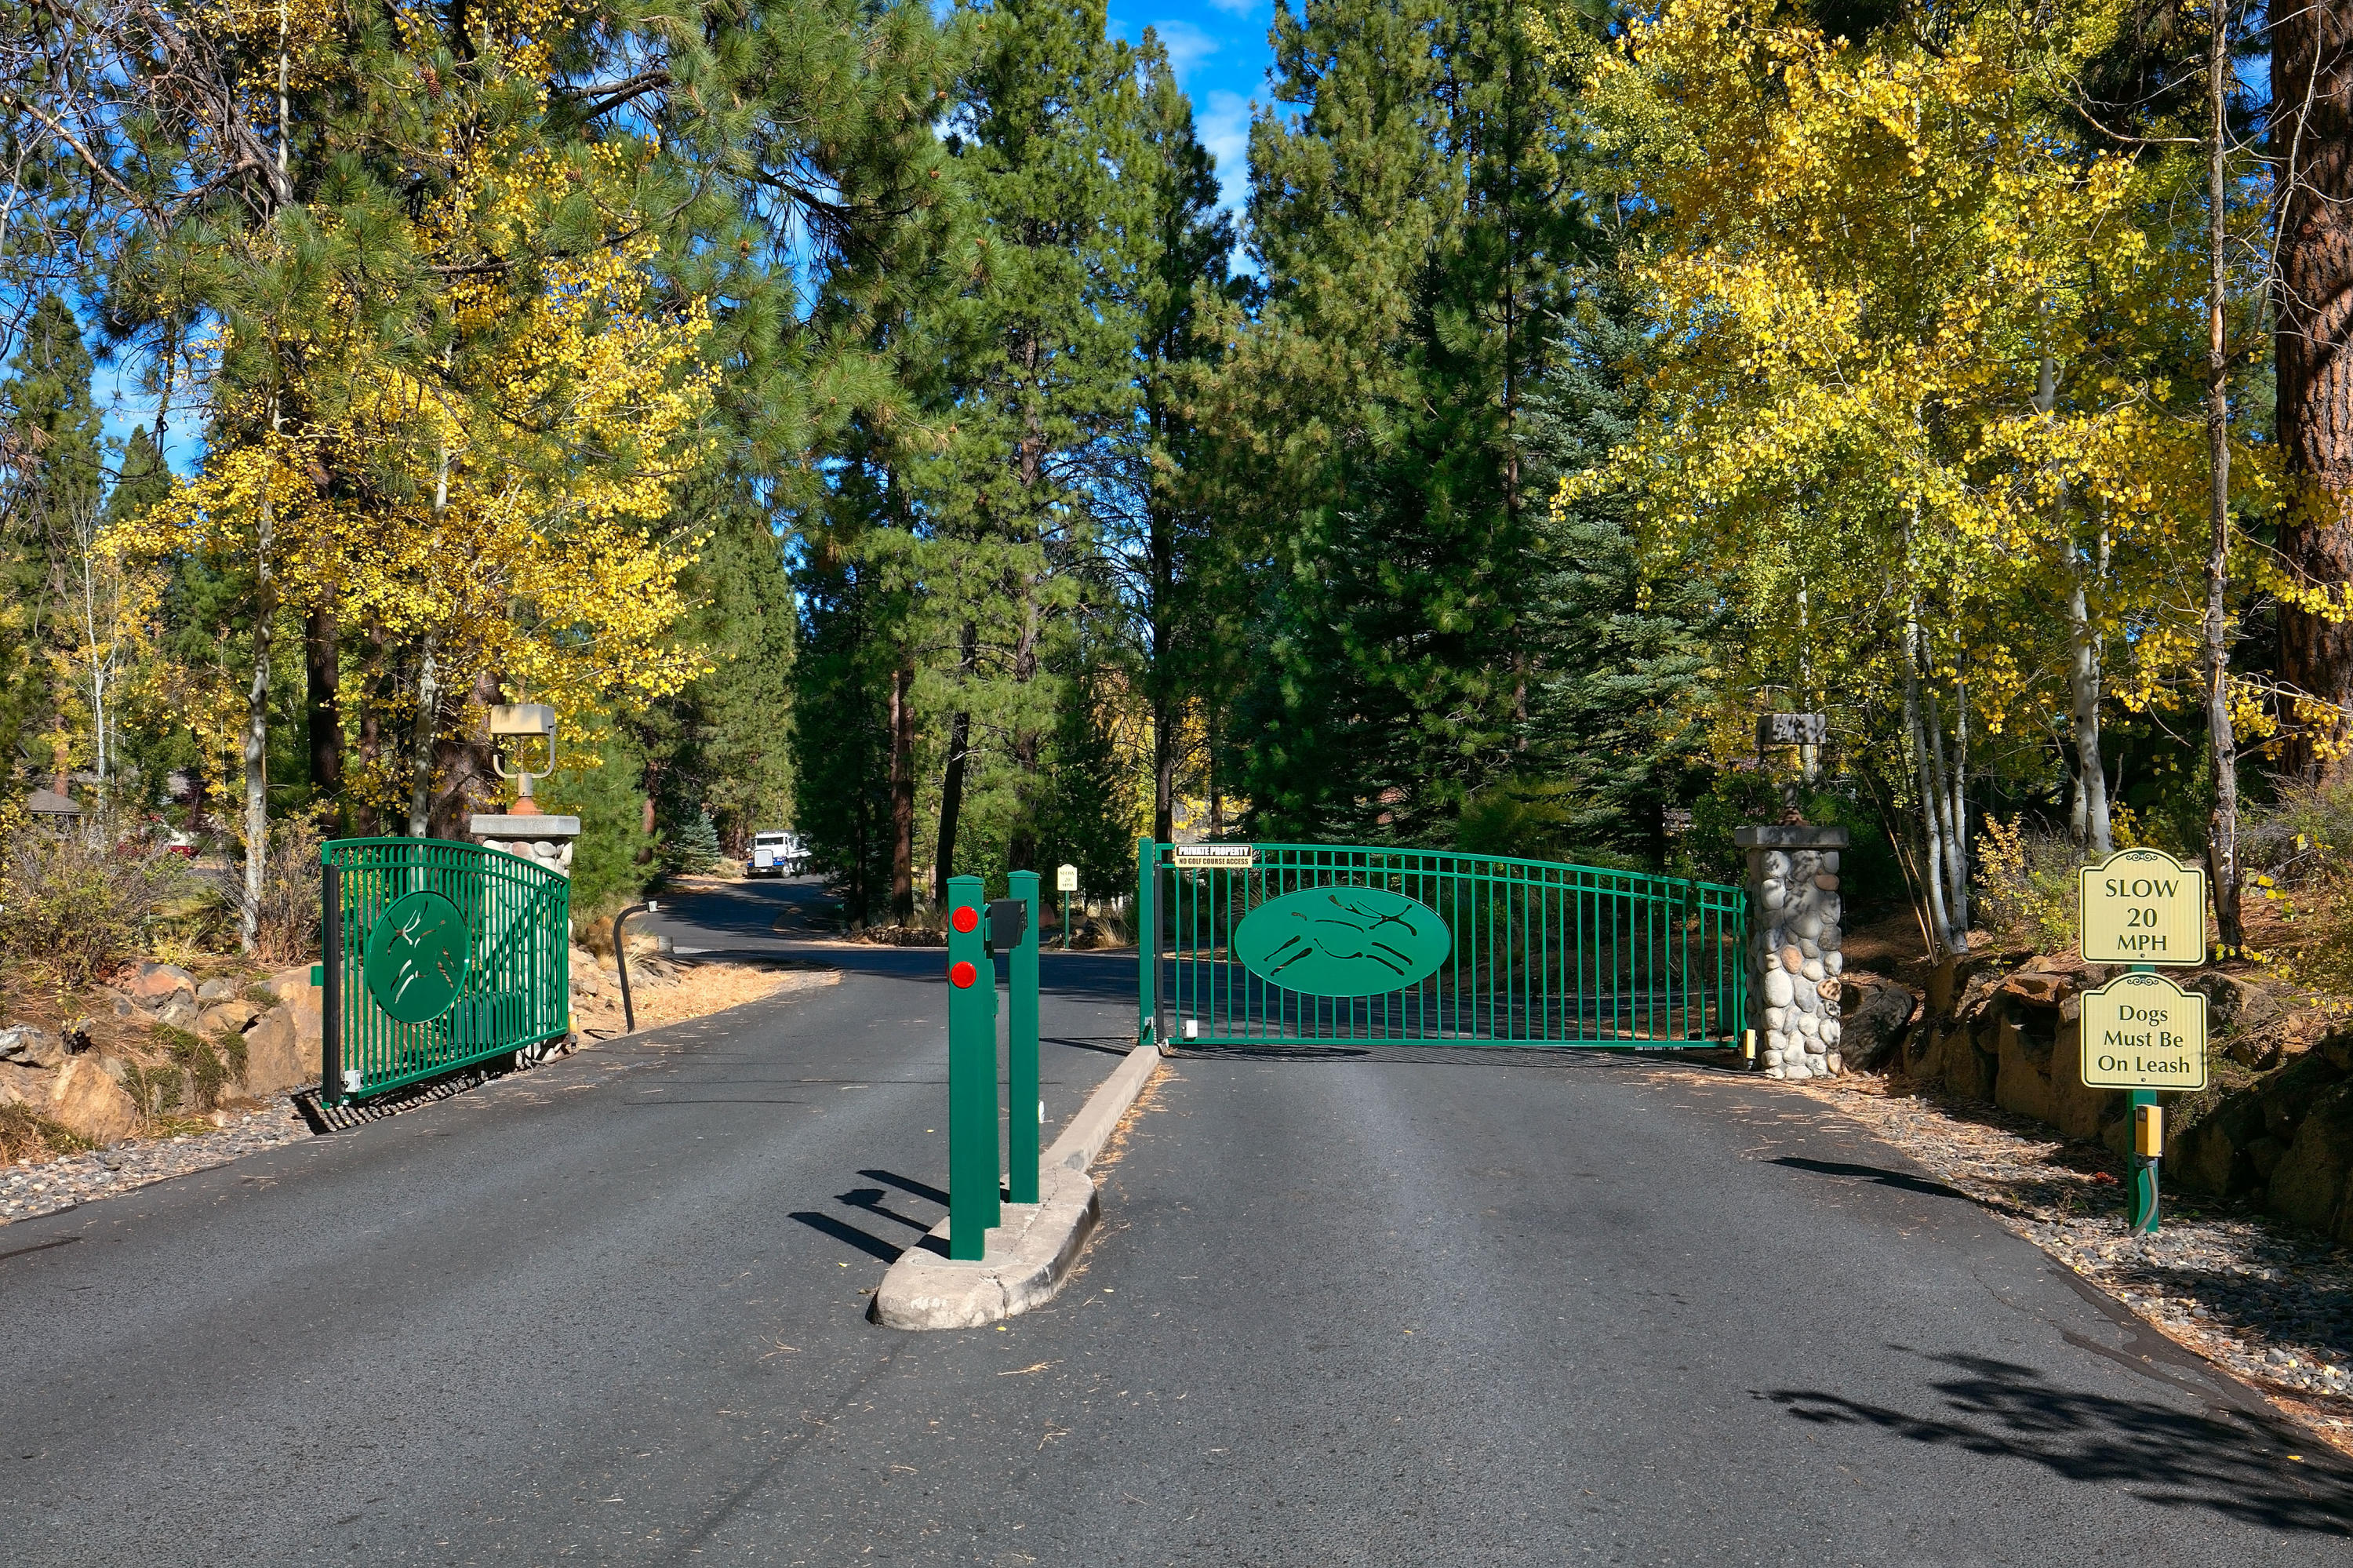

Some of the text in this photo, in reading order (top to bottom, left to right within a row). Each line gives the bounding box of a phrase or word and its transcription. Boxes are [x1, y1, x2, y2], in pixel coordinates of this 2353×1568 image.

[1178, 846, 1249, 856] PRIVATE PROPERTY
[2105, 879, 2179, 897] SLOW
[2126, 908, 2158, 927] 20
[2117, 934, 2167, 951] MPH
[2119, 1005, 2168, 1027] Dogs
[2104, 1030, 2184, 1048] Must Be
[2098, 1055, 2191, 1073] On Leash
